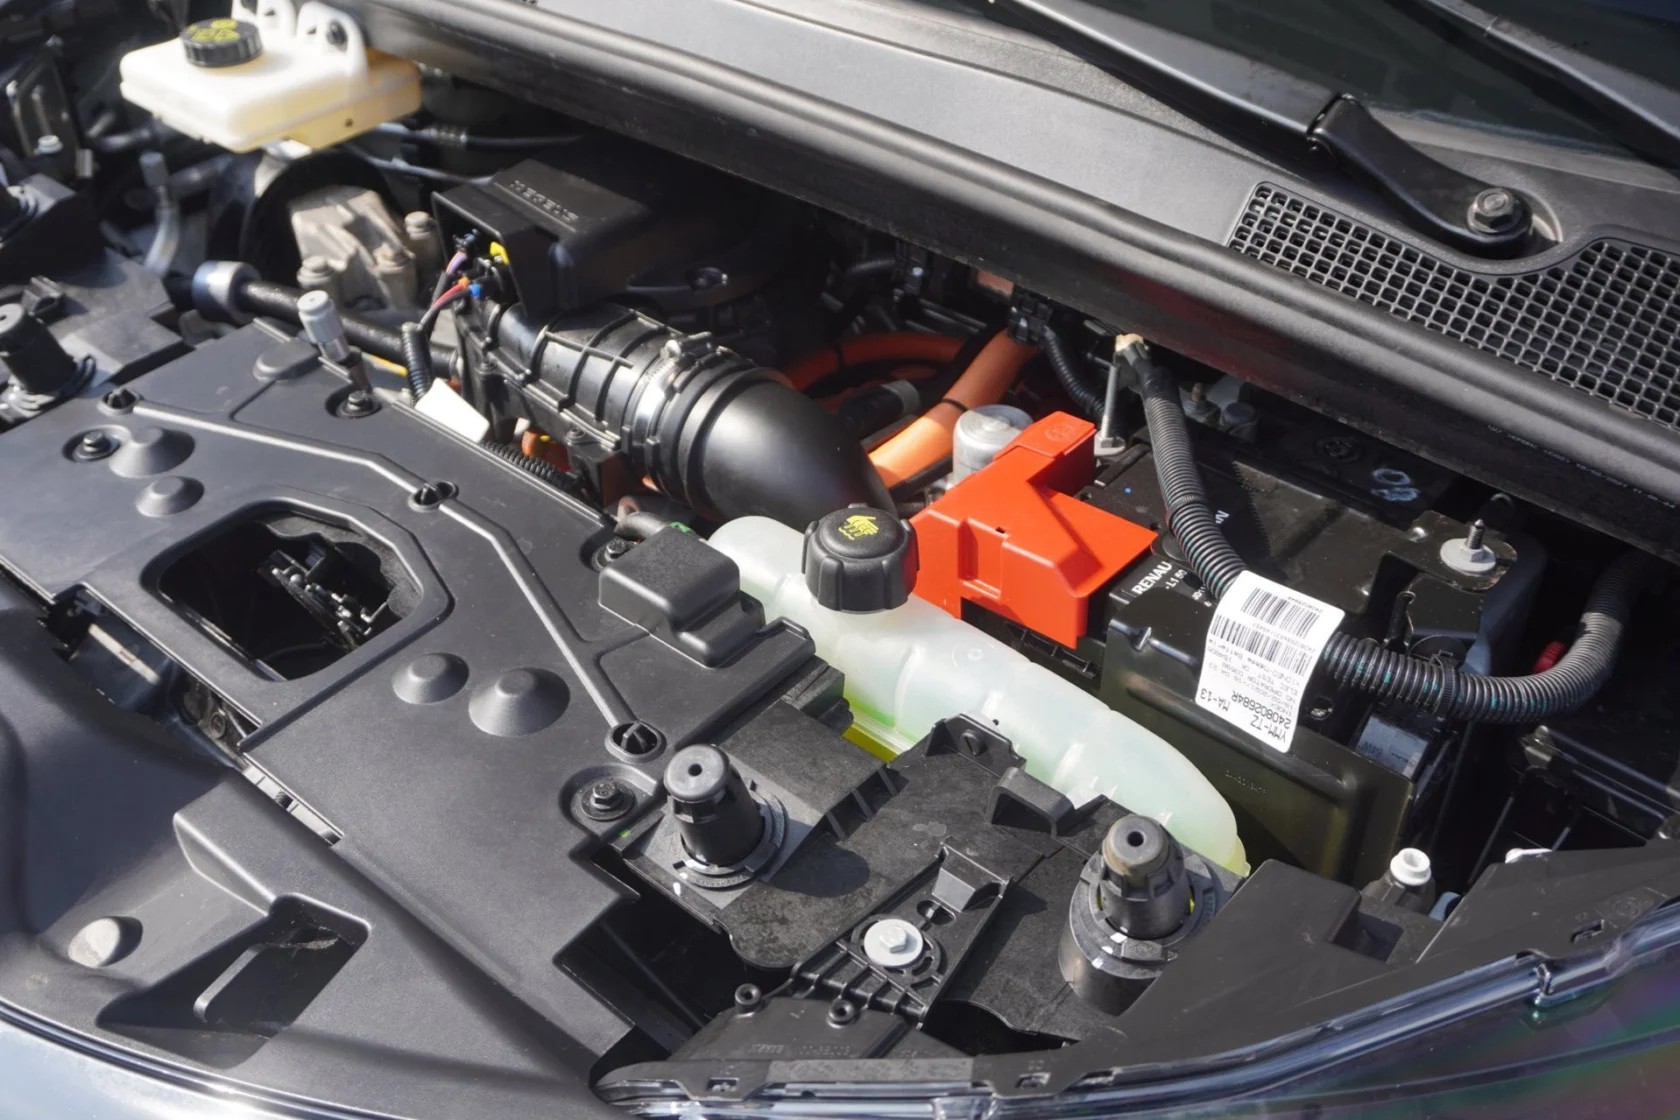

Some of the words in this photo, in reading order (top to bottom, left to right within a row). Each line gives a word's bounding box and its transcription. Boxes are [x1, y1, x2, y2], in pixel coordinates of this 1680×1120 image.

[1199, 687, 1230, 712] MA-13
[1246, 675, 1282, 697] OPERATOR
[1230, 689, 1291, 730] 240802684R
[1249, 713, 1286, 743] YMM-TZ
